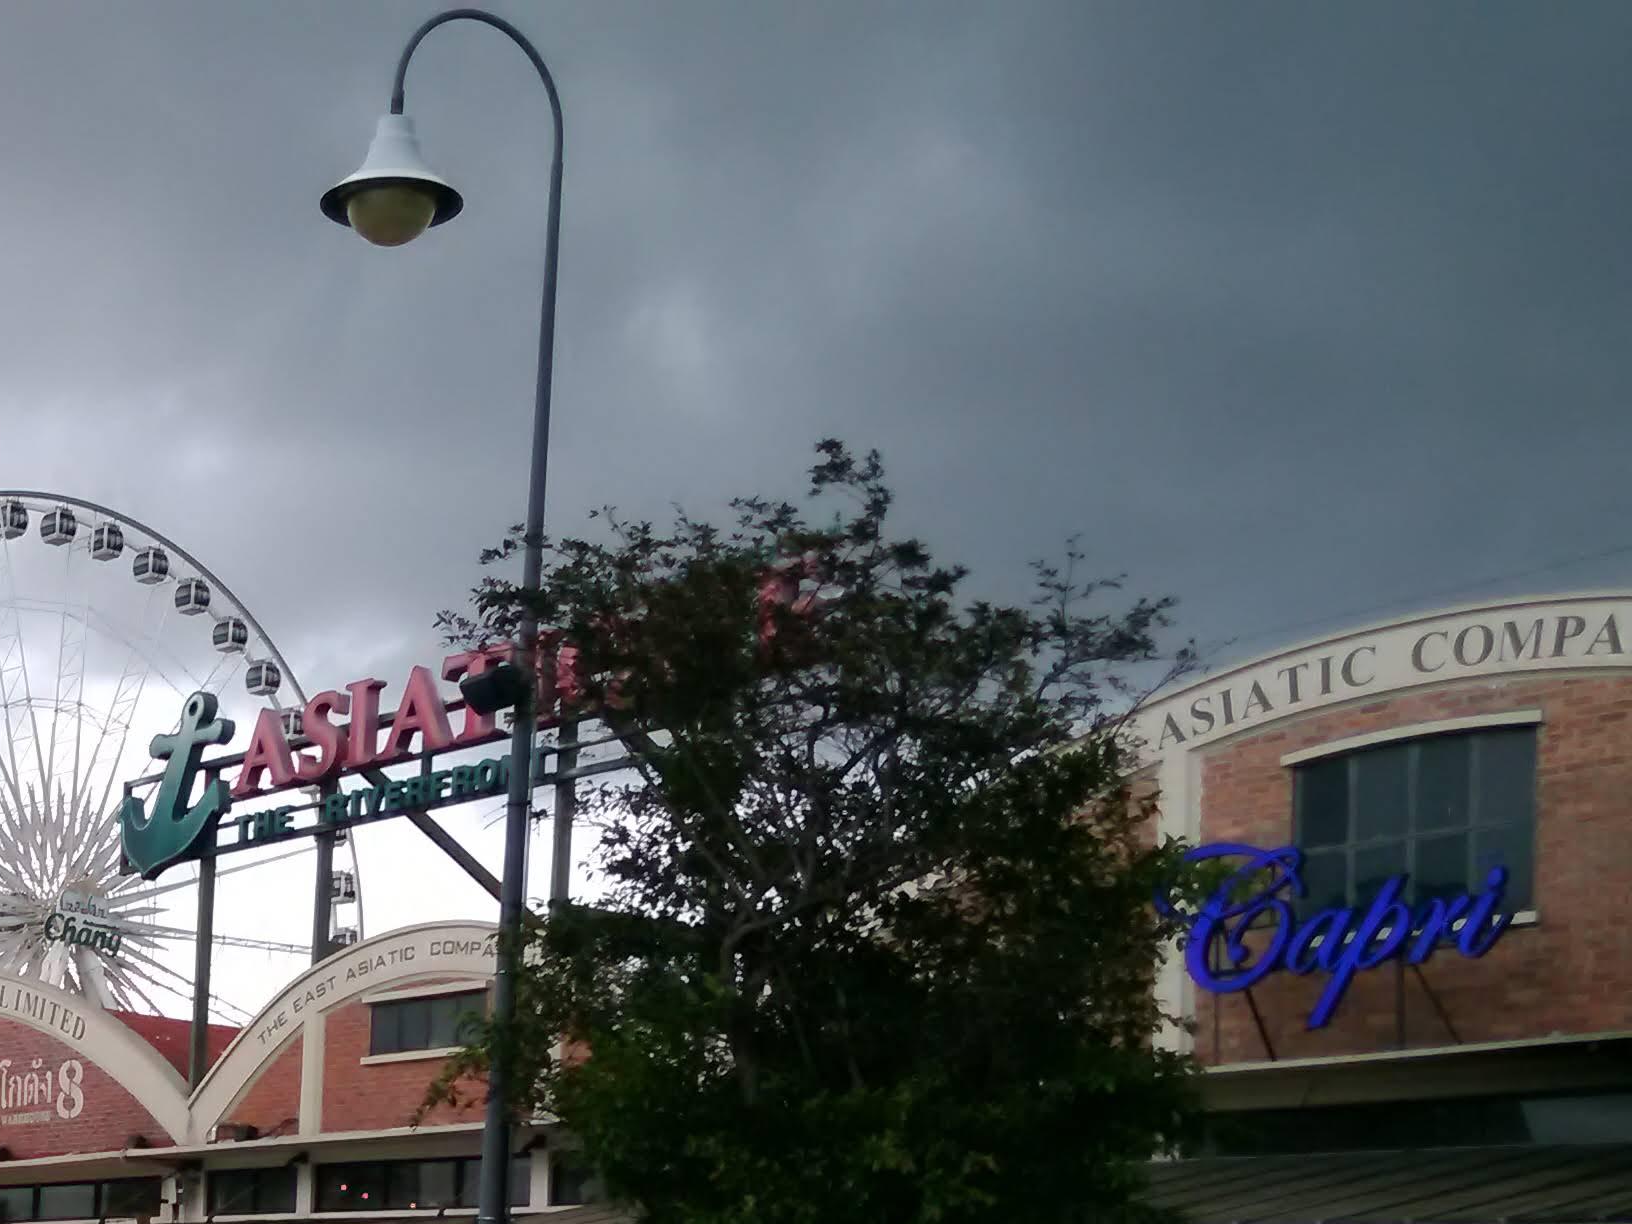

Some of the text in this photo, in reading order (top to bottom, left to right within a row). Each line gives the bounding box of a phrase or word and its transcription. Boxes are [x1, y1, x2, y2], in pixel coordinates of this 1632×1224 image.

[1158, 646, 1377, 750] ASIATIC
[236, 804, 294, 843] THE
[44, 912, 122, 957] Chang
[1155, 842, 1509, 1031] Capri
[257, 939, 498, 1045] THE EAST ASIATIC COMPA
[56, 1059, 84, 1119] 8
